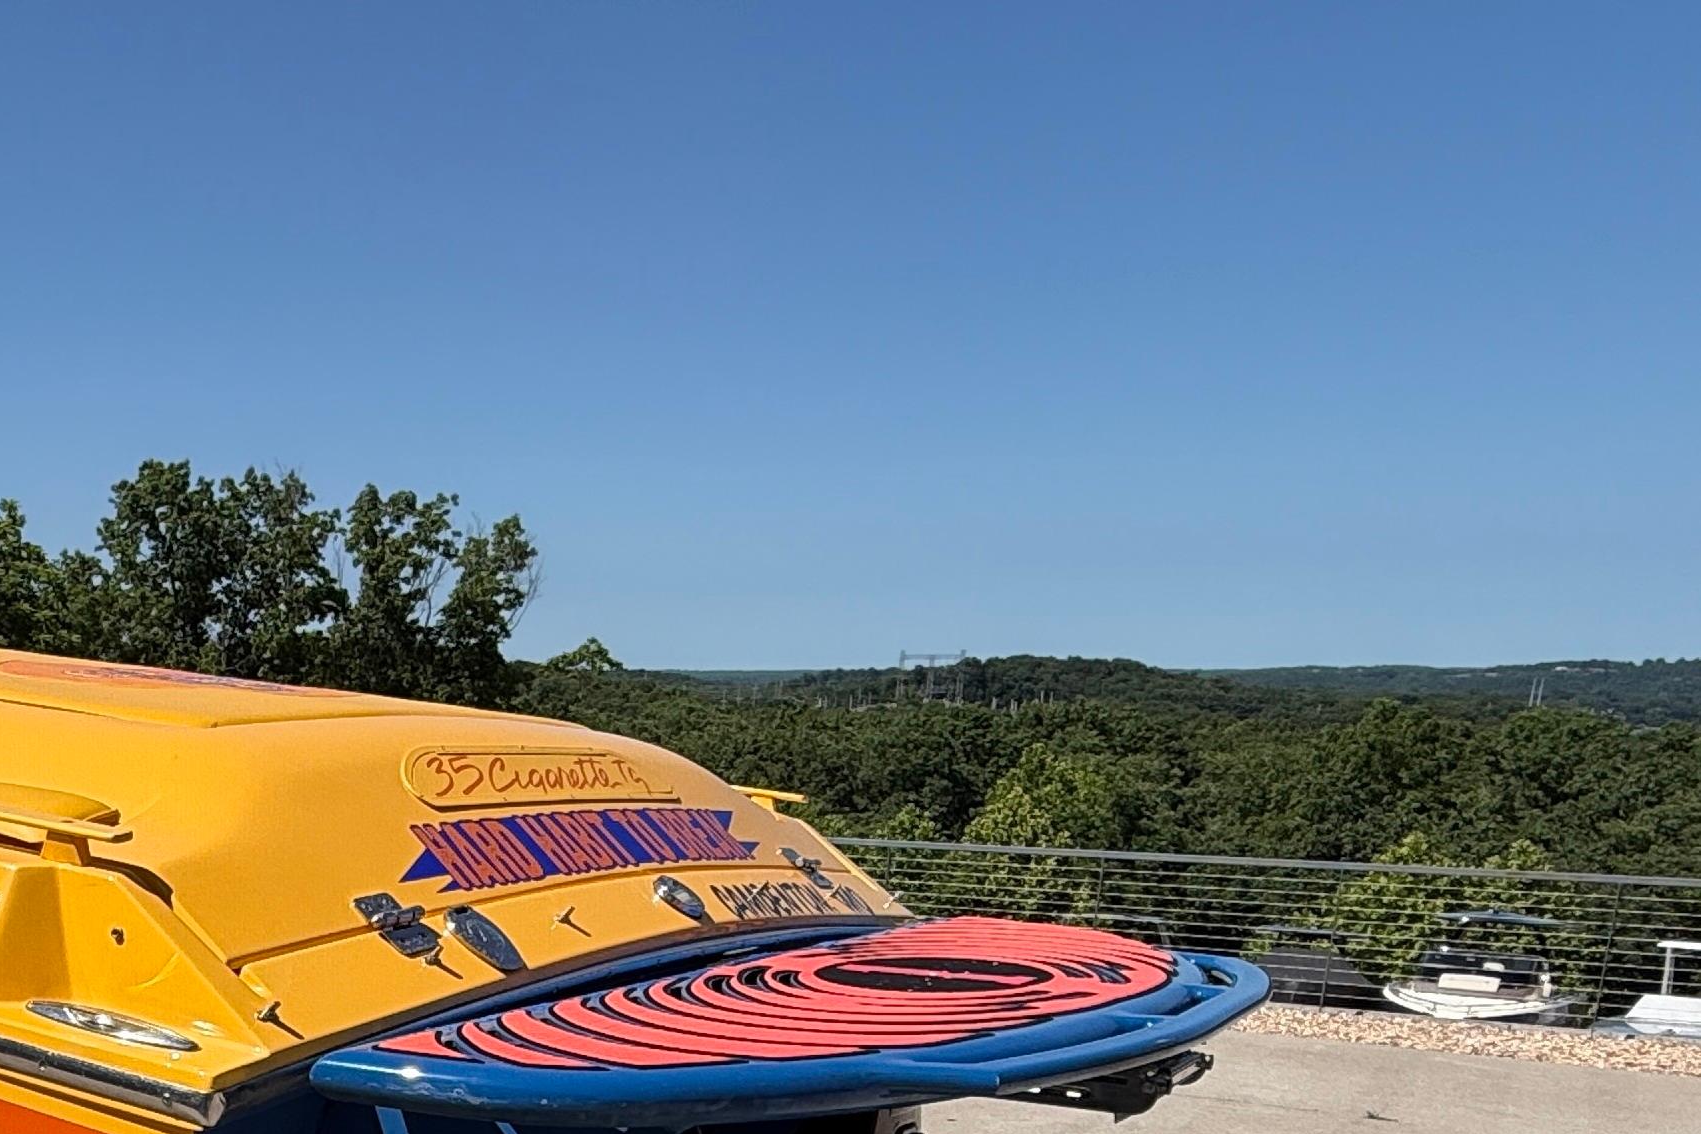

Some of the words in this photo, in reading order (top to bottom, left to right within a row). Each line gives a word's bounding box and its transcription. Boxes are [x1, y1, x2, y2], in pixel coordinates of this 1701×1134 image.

[426, 756, 484, 797] 35
[489, 757, 616, 794] Cigarette
[410, 816, 546, 891] HARD
[513, 810, 640, 876] HABIT
[603, 808, 680, 864] TO
[643, 808, 756, 861] BREAK
